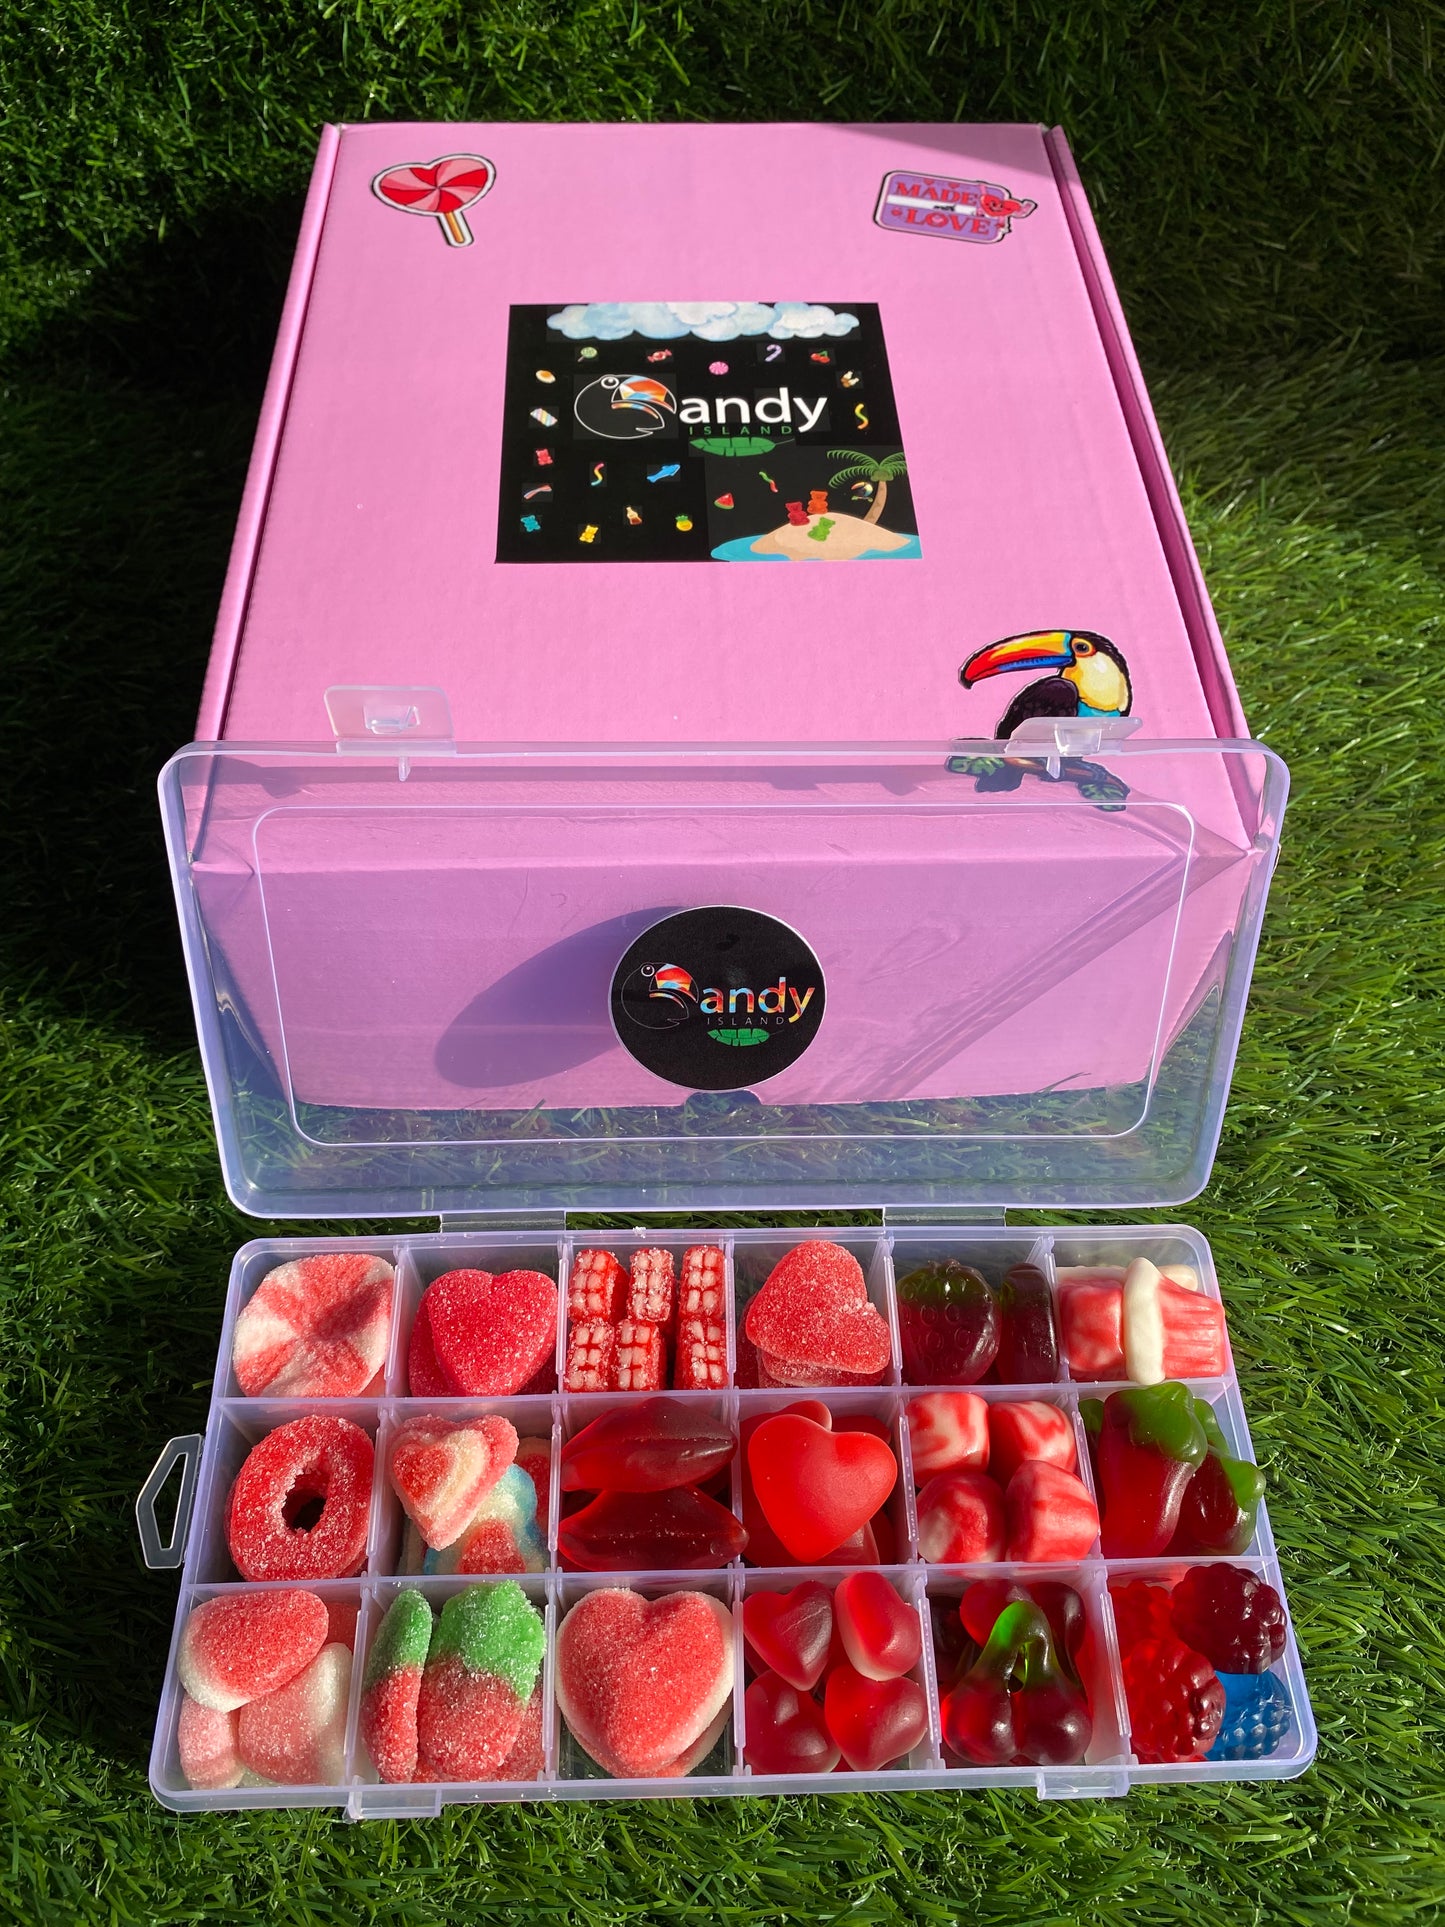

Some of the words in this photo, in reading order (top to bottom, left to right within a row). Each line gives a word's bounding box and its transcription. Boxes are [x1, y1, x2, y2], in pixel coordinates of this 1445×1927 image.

[896, 182, 978, 206] MADE
[905, 209, 989, 235] LOVE
[689, 425, 793, 435] ISLAND
[706, 1016, 784, 1025] ISLAND
